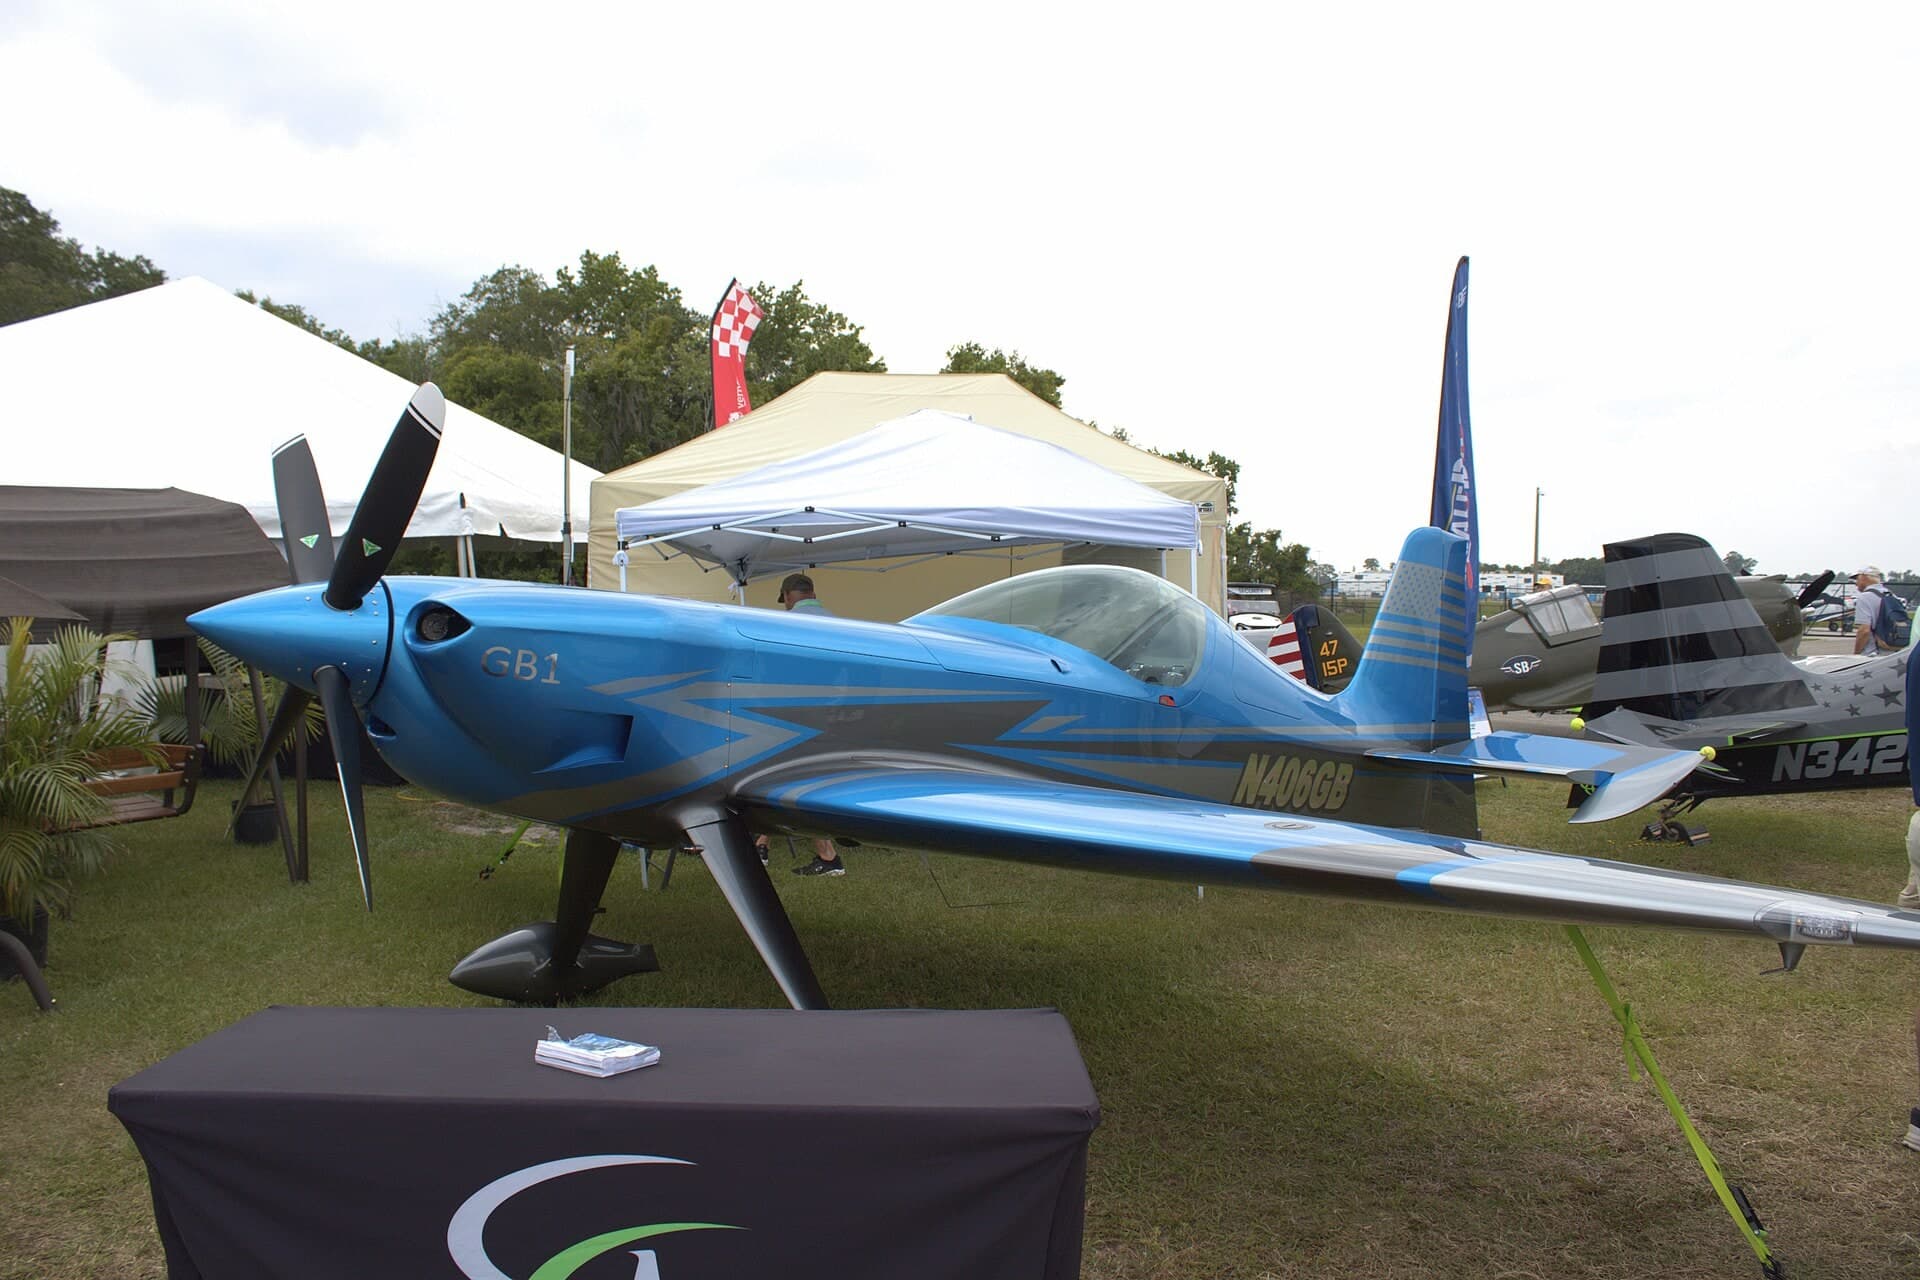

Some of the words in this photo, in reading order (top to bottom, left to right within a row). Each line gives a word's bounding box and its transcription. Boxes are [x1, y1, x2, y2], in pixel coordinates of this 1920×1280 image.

[1320, 640, 1338, 656] 47
[481, 646, 560, 685] GB1
[1322, 657, 1348, 677] 15P
[1513, 661, 1531, 674] SB
[1771, 734, 1911, 782] N342
[1231, 752, 1354, 811] N406GB
